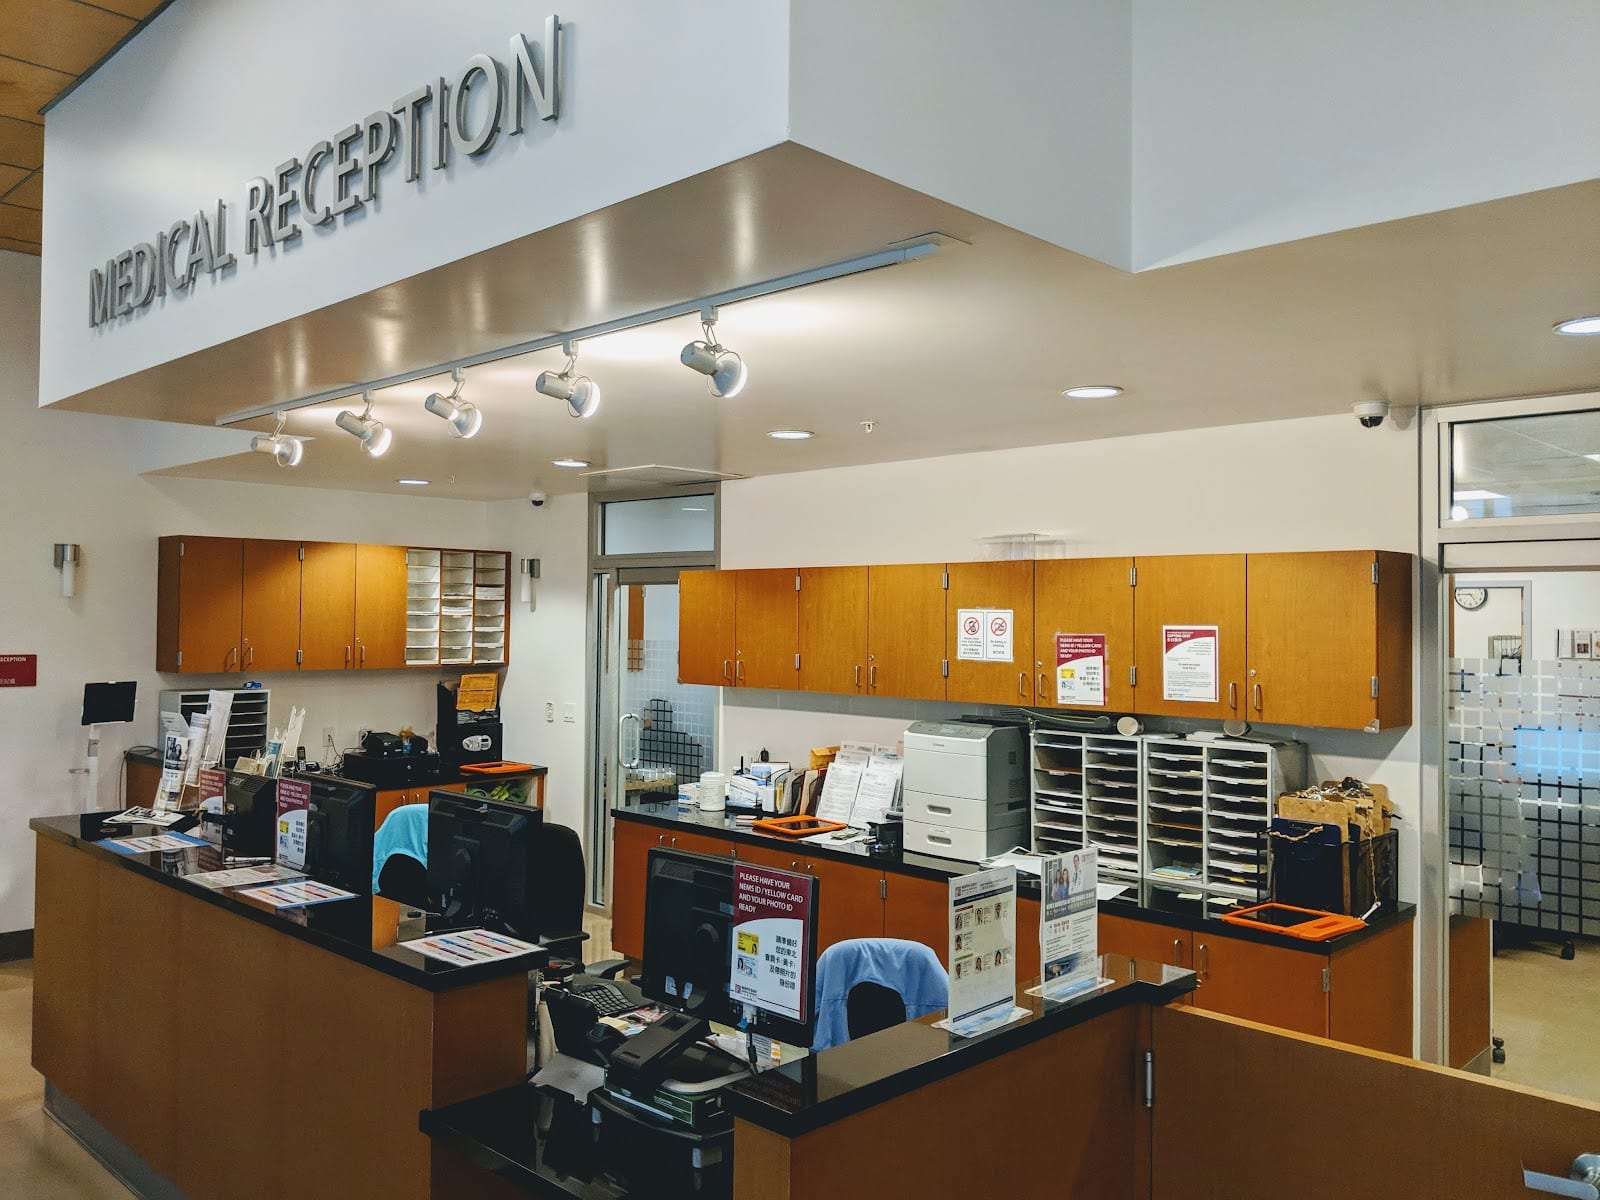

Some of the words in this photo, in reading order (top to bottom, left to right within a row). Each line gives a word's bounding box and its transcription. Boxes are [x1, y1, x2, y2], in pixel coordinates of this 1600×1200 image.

[88, 198, 236, 328] MEDICAL
[244, 14, 560, 255] RECEPTION
[740, 872, 759, 882] PLEASE
[760, 877, 774, 886] HAVE
[775, 880, 790, 889] YOUR
[739, 882, 754, 892] NEMS
[764, 888, 786, 899] YELLOW
[787, 894, 804, 903] CARD
[738, 903, 756, 913] READY
[739, 893, 751, 902] AND
[750, 896, 766, 905] YOUR
[767, 899, 786, 910] PHOTO
